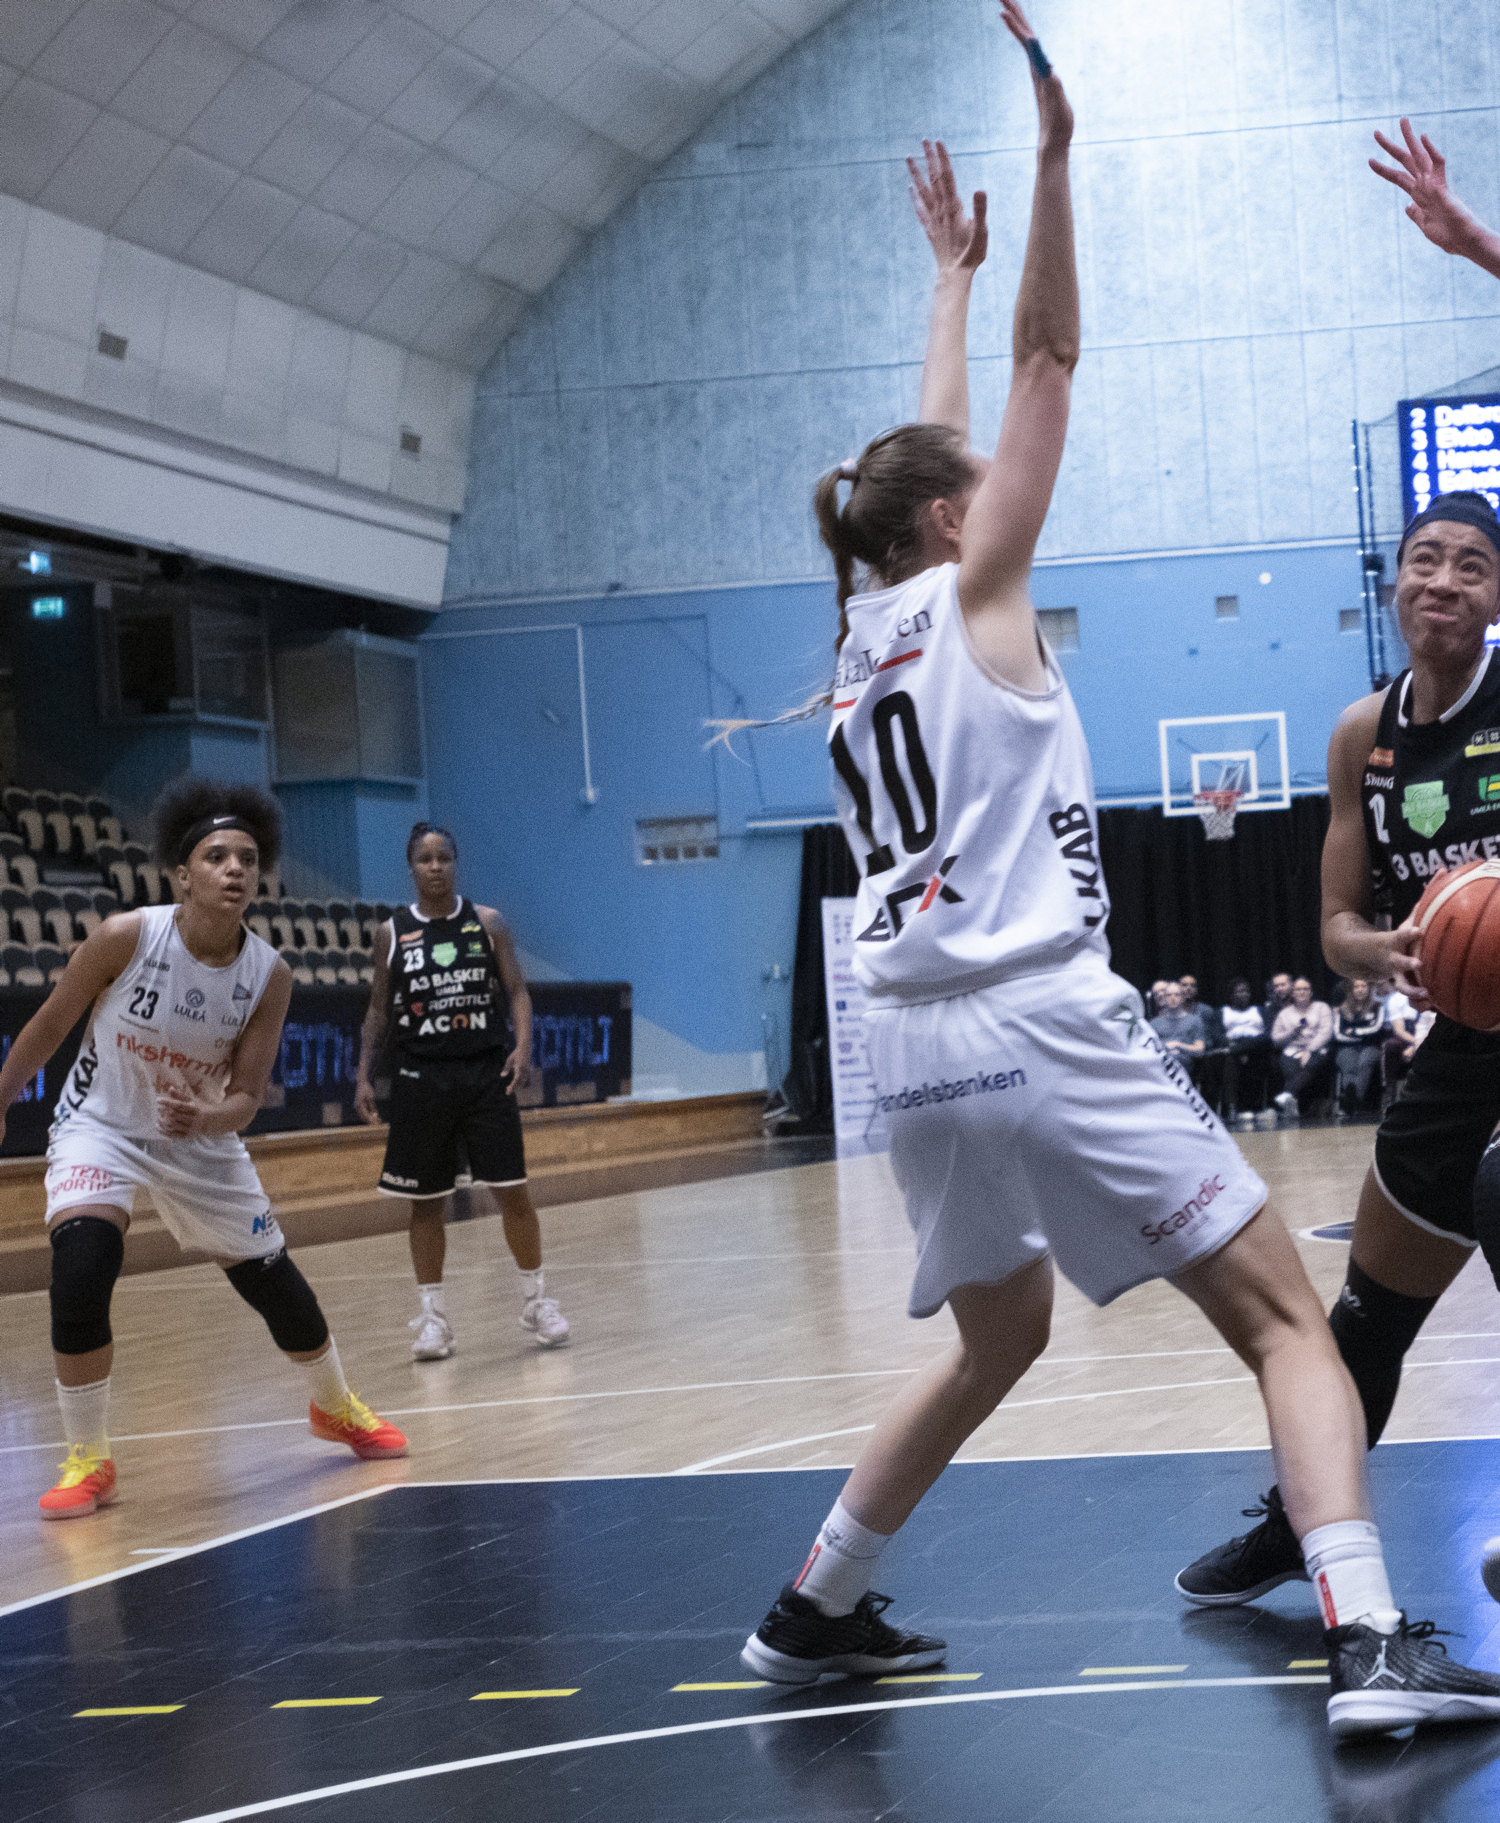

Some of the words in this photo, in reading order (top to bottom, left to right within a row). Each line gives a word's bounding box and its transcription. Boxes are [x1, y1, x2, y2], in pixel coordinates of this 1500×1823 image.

[1409, 407, 1426, 429] 2
[1411, 429, 1428, 451] 3
[1412, 450, 1428, 472] 4
[831, 690, 936, 878] 10
[404, 947, 425, 973] 23
[431, 967, 486, 987] BASKET
[129, 986, 159, 1020] 23
[879, 1068, 1027, 1113] andelsbanken
[1141, 1174, 1226, 1245] Scandic
